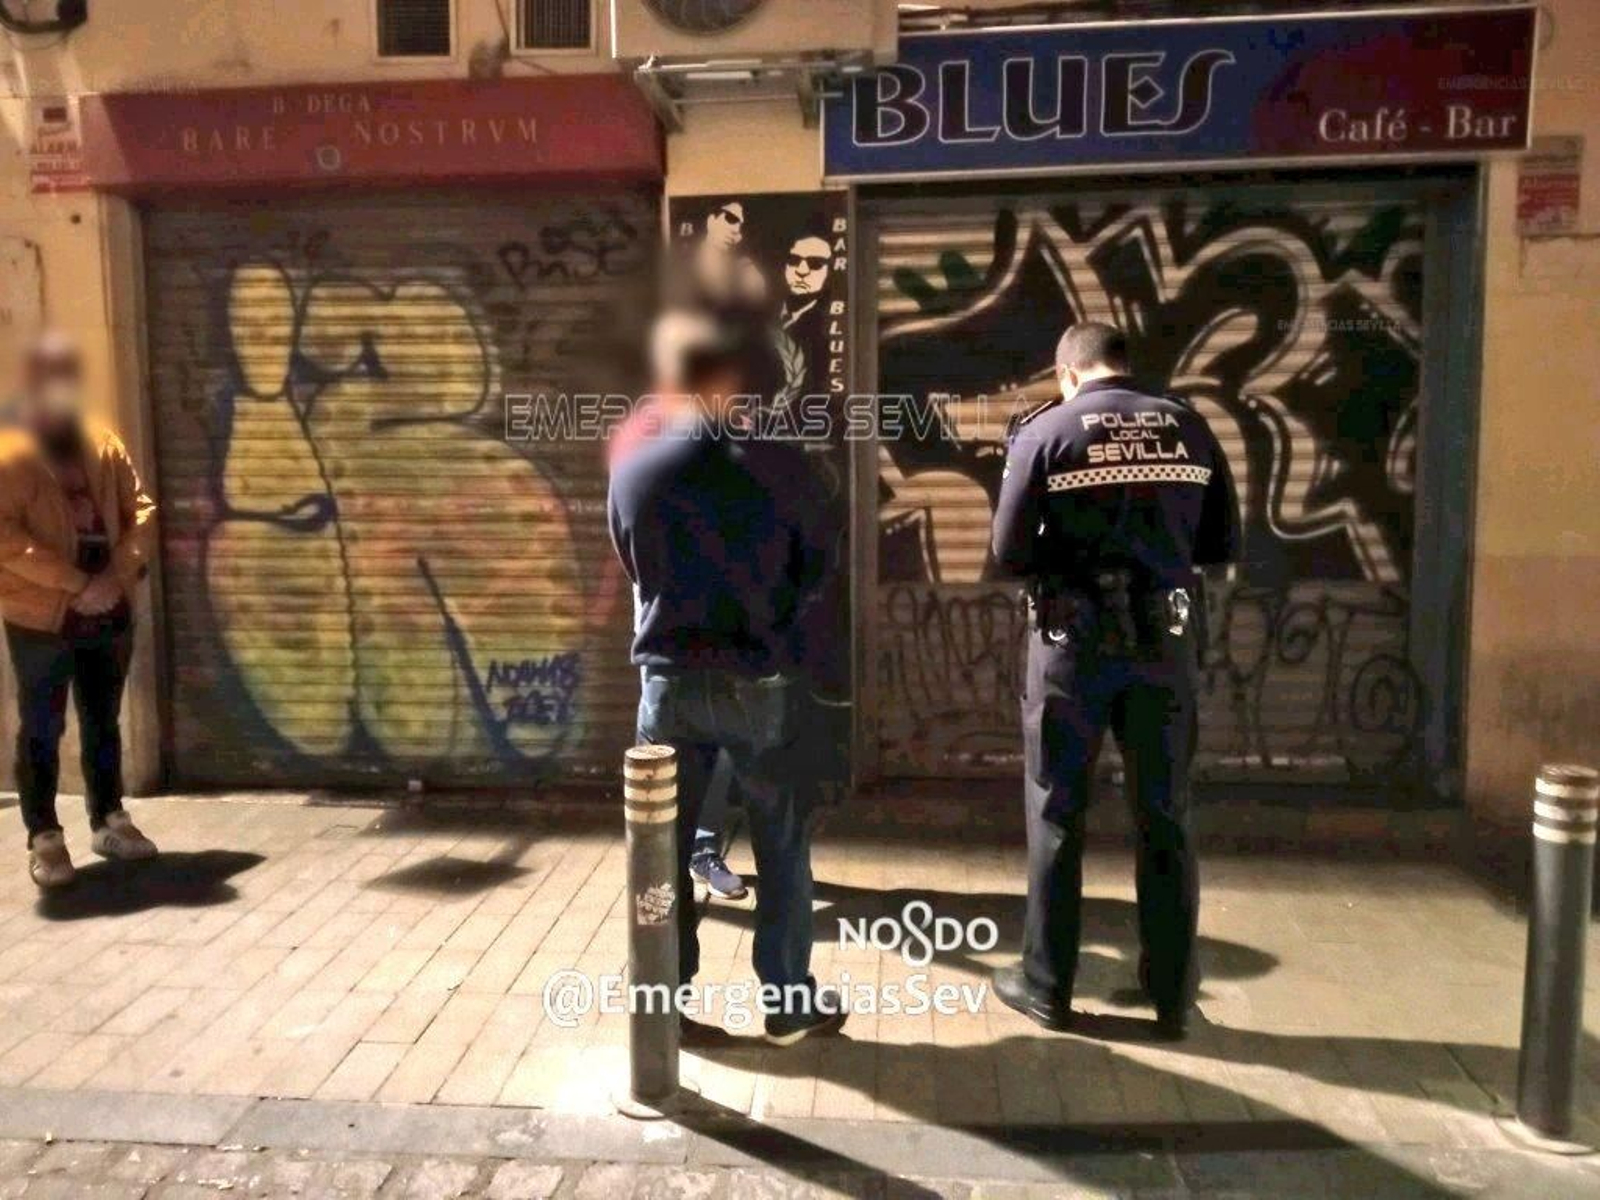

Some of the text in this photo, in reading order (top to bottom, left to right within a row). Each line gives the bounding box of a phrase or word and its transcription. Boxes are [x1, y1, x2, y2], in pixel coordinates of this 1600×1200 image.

[852, 50, 1235, 147] BLUES
[353, 118, 539, 146] NOSTRVM
[1318, 108, 1408, 143] Café
[1444, 103, 1517, 140] Bar
[828, 217, 848, 393] BAR BLUES
[1081, 412, 1179, 430] POLICIA
[1110, 429, 1160, 441] LOCAL
[1087, 442, 1189, 463] SEVILLA
